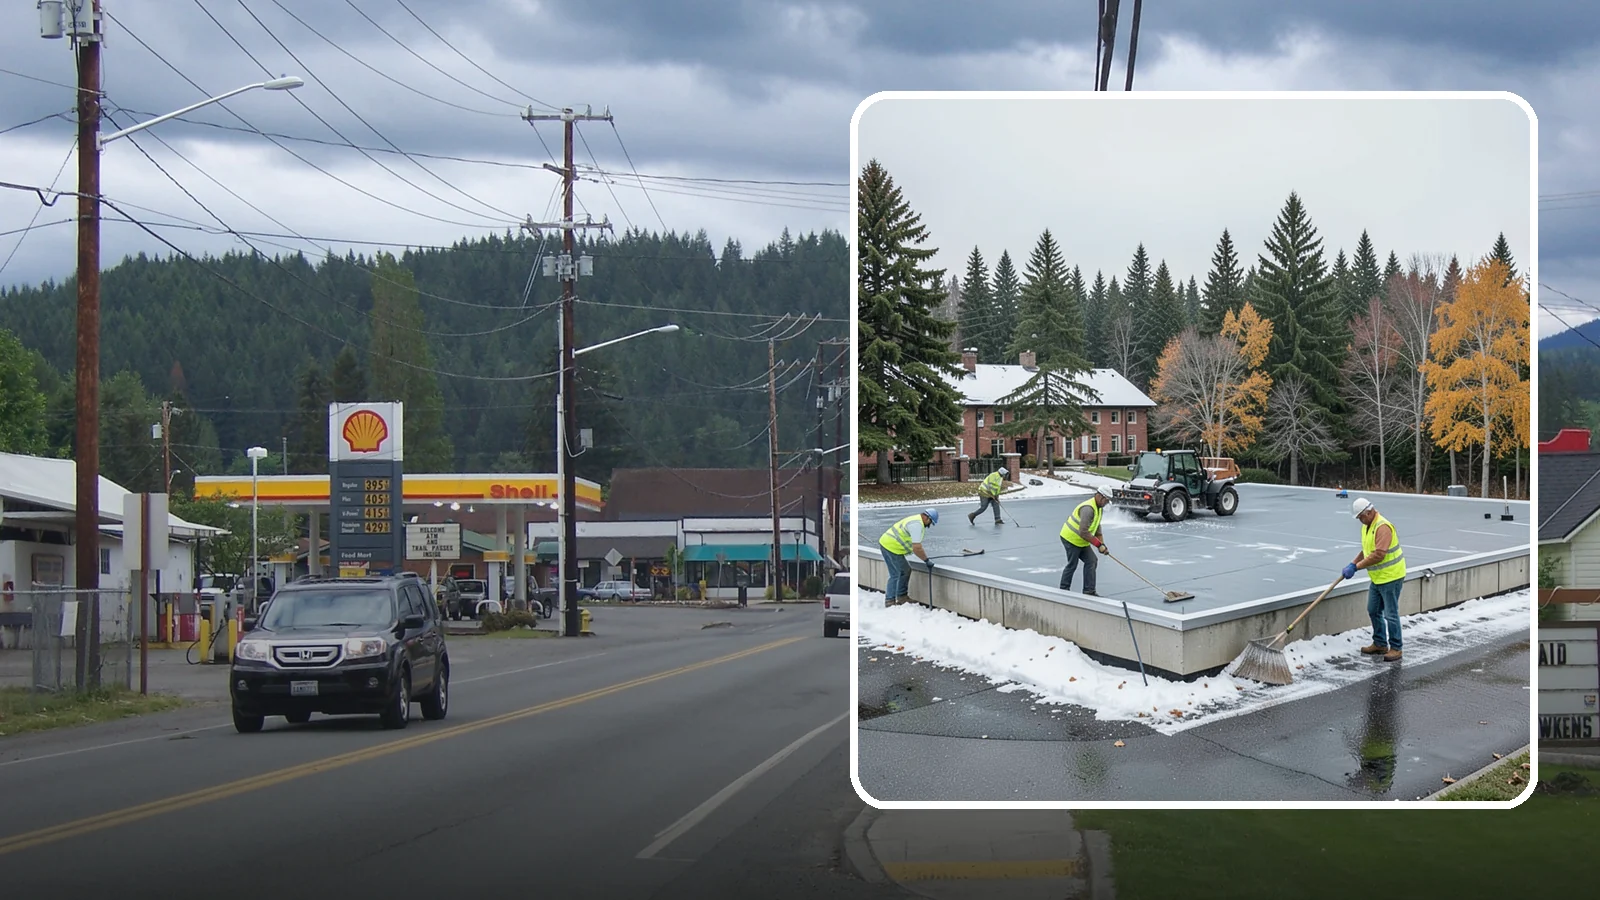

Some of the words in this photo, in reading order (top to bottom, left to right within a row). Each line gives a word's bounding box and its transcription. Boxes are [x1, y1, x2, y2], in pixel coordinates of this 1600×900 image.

[365, 480, 384, 490] 395
[490, 484, 547, 499] Shell
[365, 494, 384, 504] 405
[365, 508, 384, 518] 415
[365, 522, 384, 533] 429
